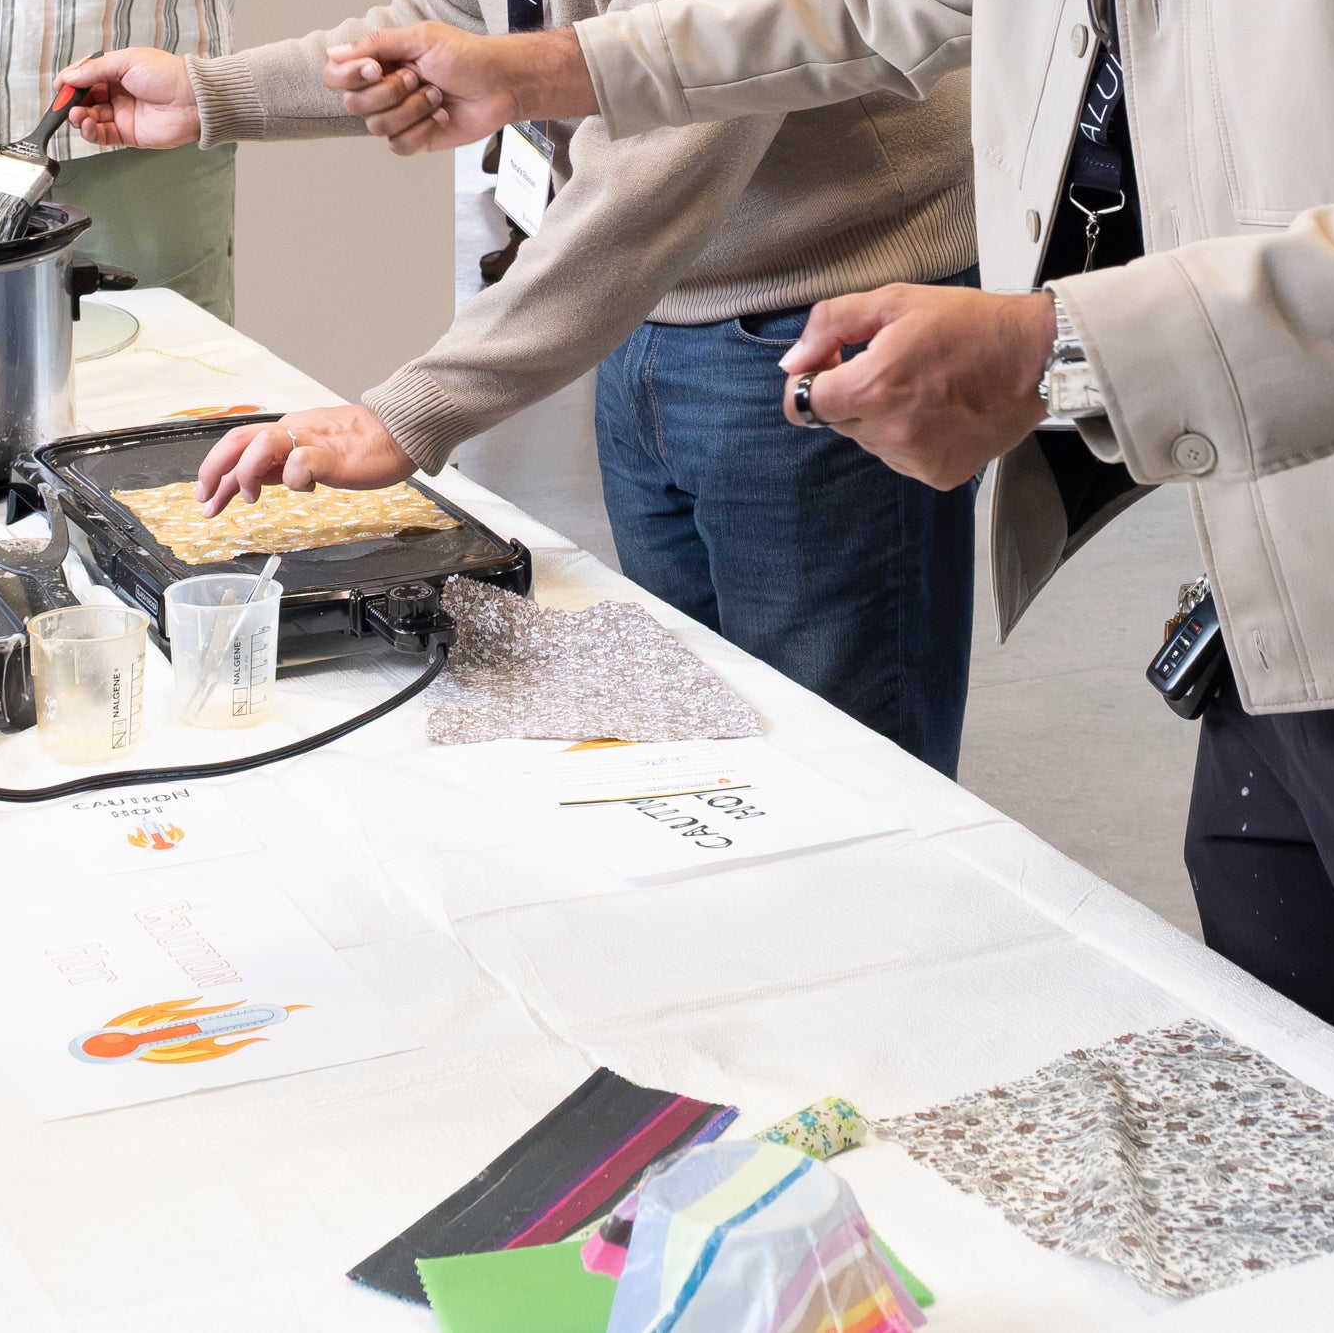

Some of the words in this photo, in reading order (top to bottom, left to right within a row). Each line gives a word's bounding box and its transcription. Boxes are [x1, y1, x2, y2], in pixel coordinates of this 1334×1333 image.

[234, 641, 242, 685] NALGENE
[112, 672, 121, 718] NALGENE
[72, 788, 190, 810] CAUTION
[111, 806, 166, 818] HOT
[45, 942, 118, 986] HOT
